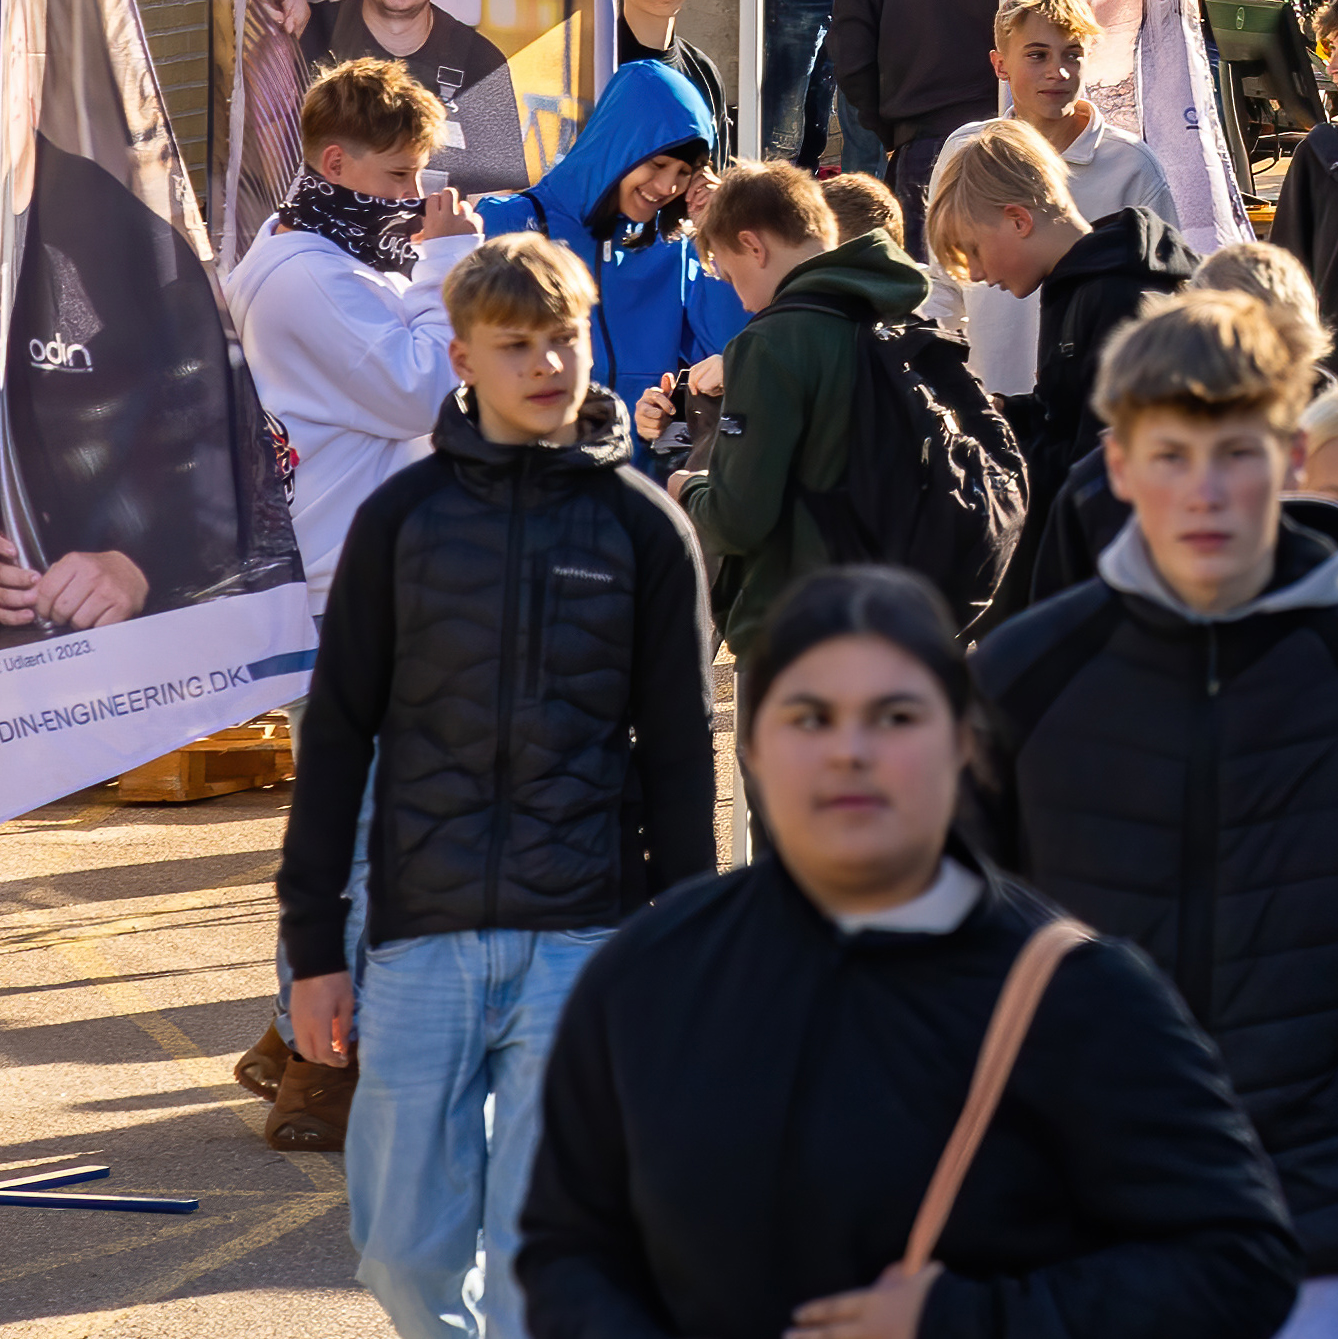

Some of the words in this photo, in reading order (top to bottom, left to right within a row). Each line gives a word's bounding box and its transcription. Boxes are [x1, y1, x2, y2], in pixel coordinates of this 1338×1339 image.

[29, 332, 92, 367] odin
[48, 649, 54, 662] i
[55, 639, 96, 661] 2023.
[0, 663, 250, 743] DIN-ENGINEERING.DK
